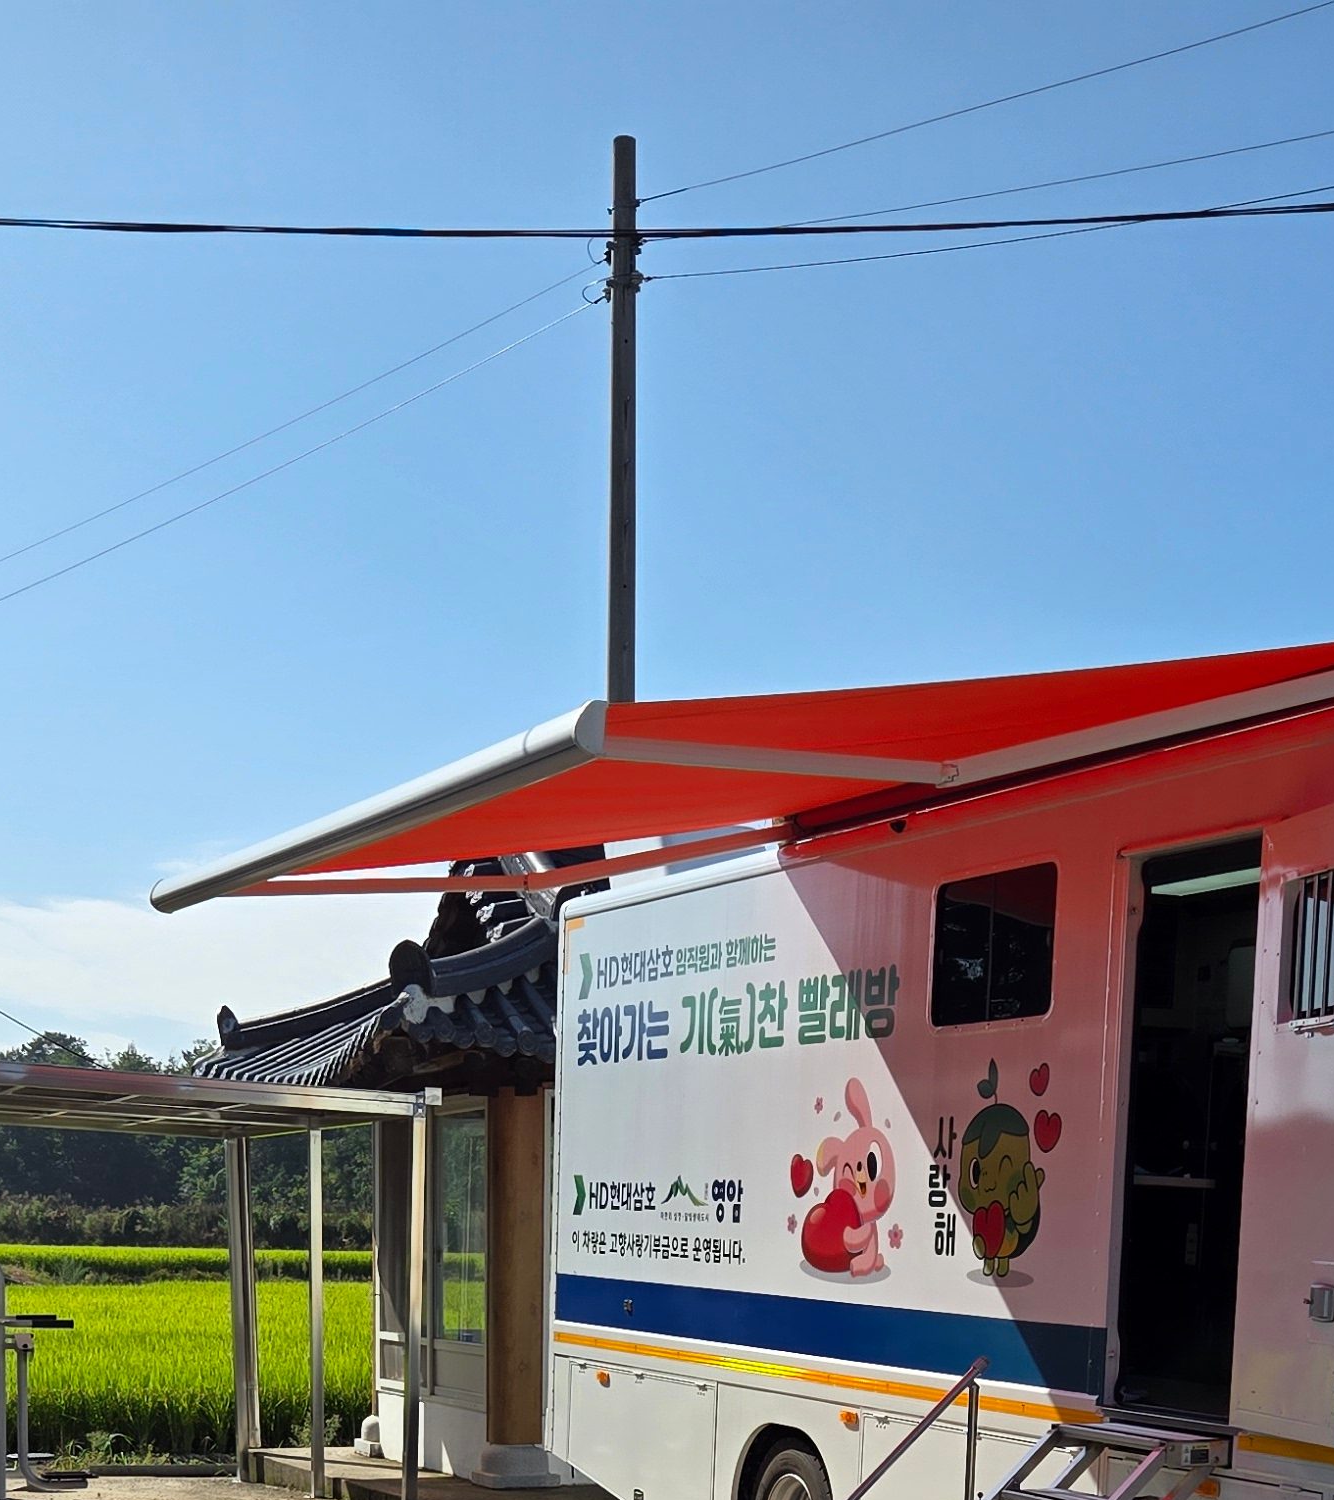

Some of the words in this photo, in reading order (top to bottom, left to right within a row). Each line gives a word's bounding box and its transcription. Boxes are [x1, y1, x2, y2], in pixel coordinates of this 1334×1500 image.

[597, 945, 674, 990] HD현대삼호
[675, 942, 722, 976] 임직원과
[725, 934, 776, 968] 함께하는
[577, 1000, 670, 1067] 찾아가는
[679, 980, 788, 1056] 기(氣)찬
[797, 964, 900, 1045] 빨래방
[588, 1180, 656, 1212] HD현대삼호
[711, 1179, 744, 1224] 영암
[928, 1116, 957, 1257] 사랑해
[571, 1230, 580, 1253] 이
[582, 1231, 607, 1255] 차량은
[609, 1231, 690, 1260] 고향사랑기부금으로
[692, 1236, 746, 1265] 운영됩니다.
